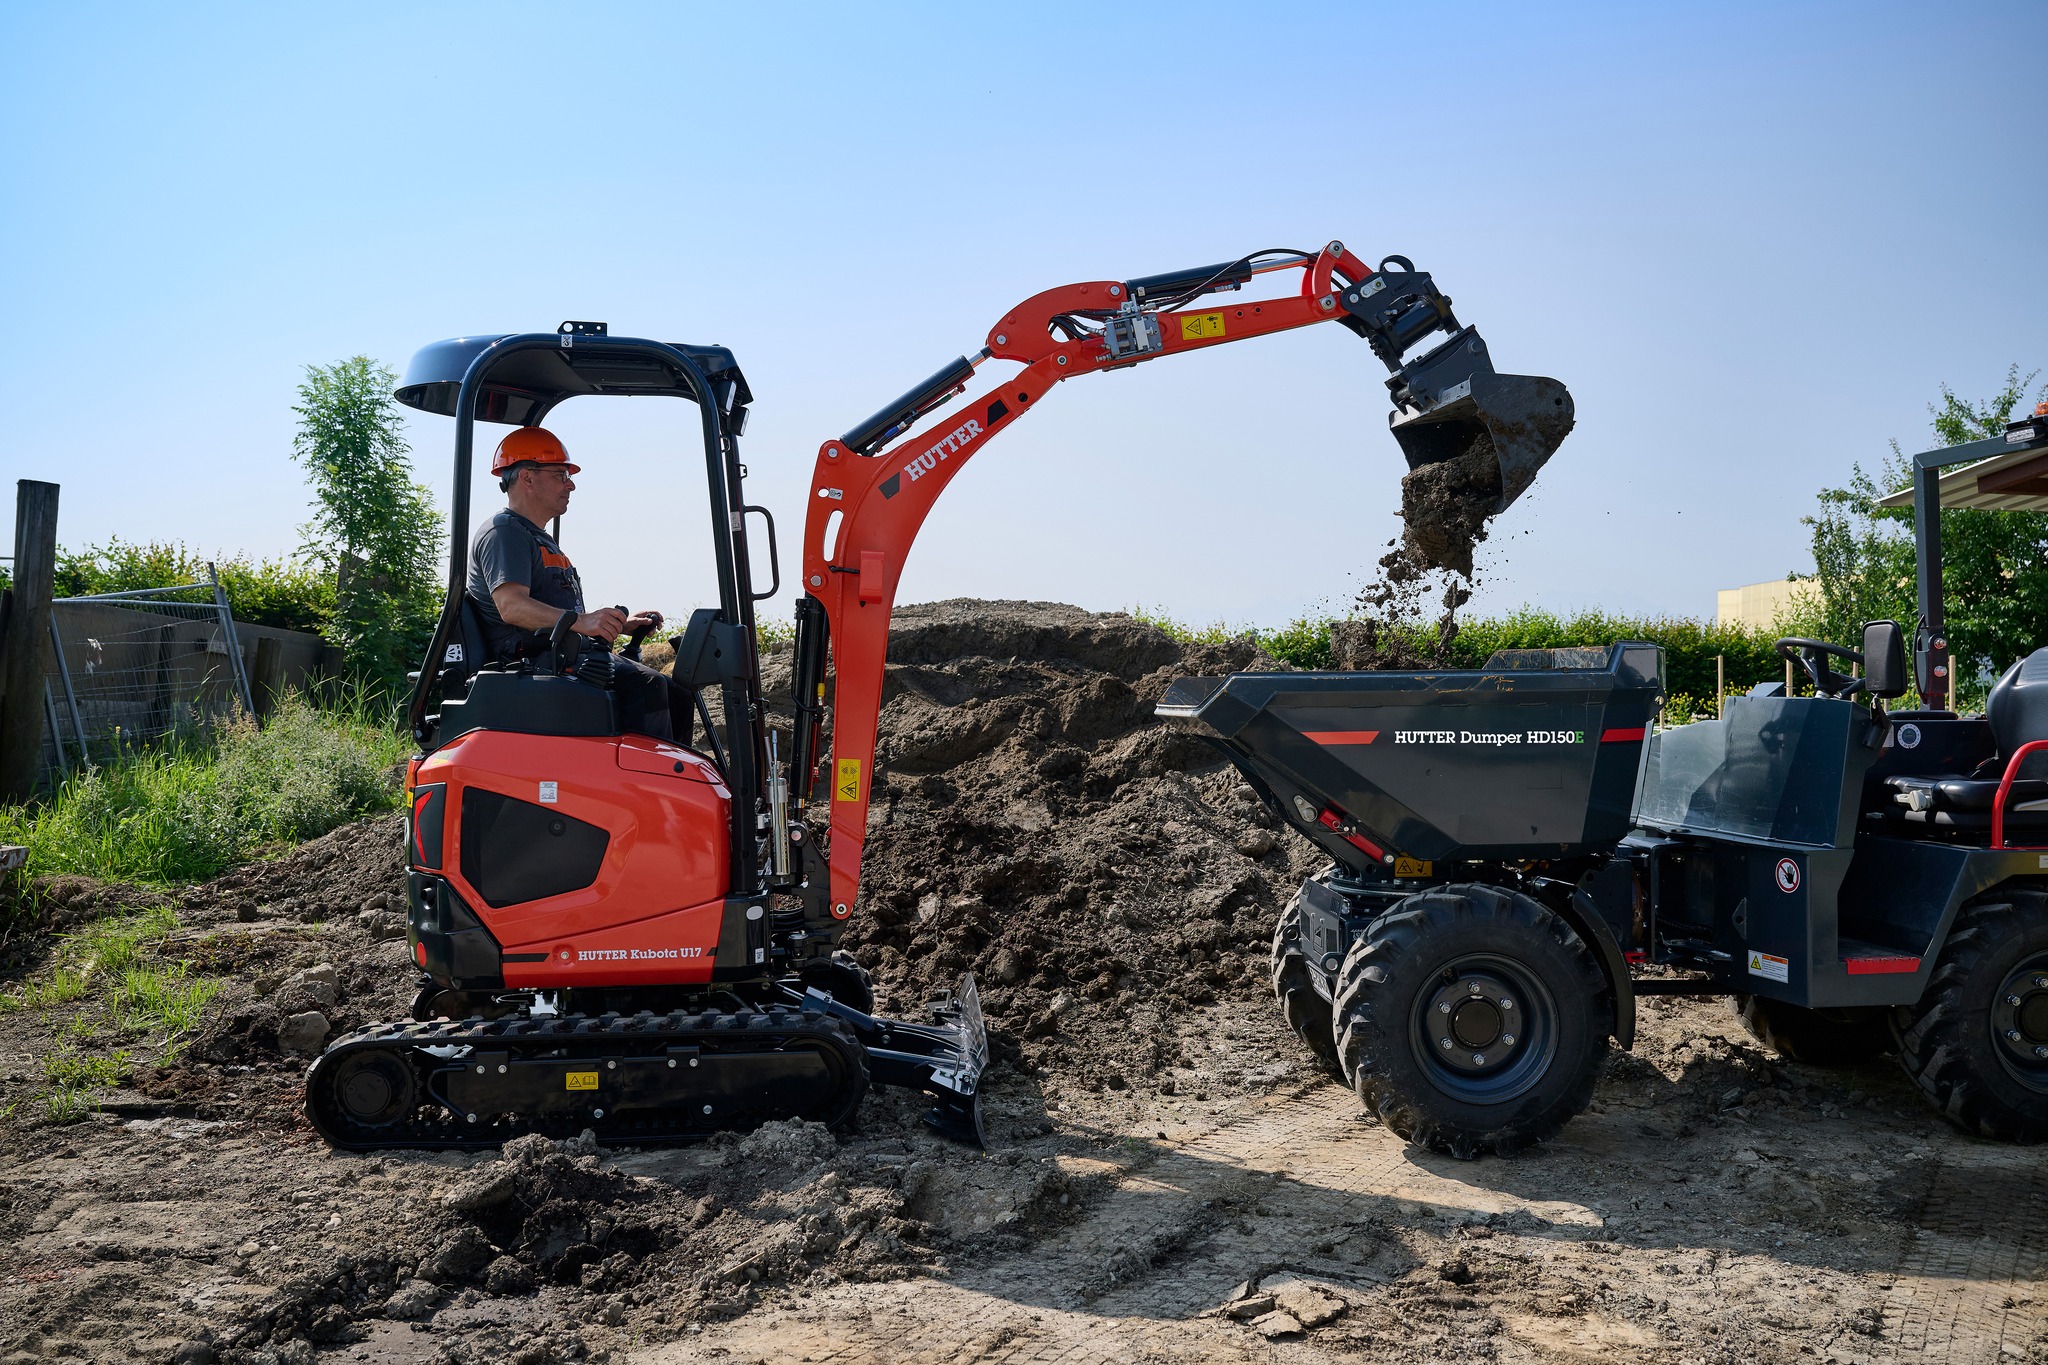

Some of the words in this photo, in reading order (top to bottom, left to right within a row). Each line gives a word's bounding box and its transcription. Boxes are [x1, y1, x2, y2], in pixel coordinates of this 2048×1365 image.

[903, 418, 984, 482] HUTTER
[1394, 730, 1456, 744] HUTTER
[1460, 730, 1522, 747] Dumper
[1526, 730, 1585, 744] HD150E
[577, 949, 628, 961] HUTTER
[630, 948, 678, 960] Kubota
[680, 947, 702, 958] U17
